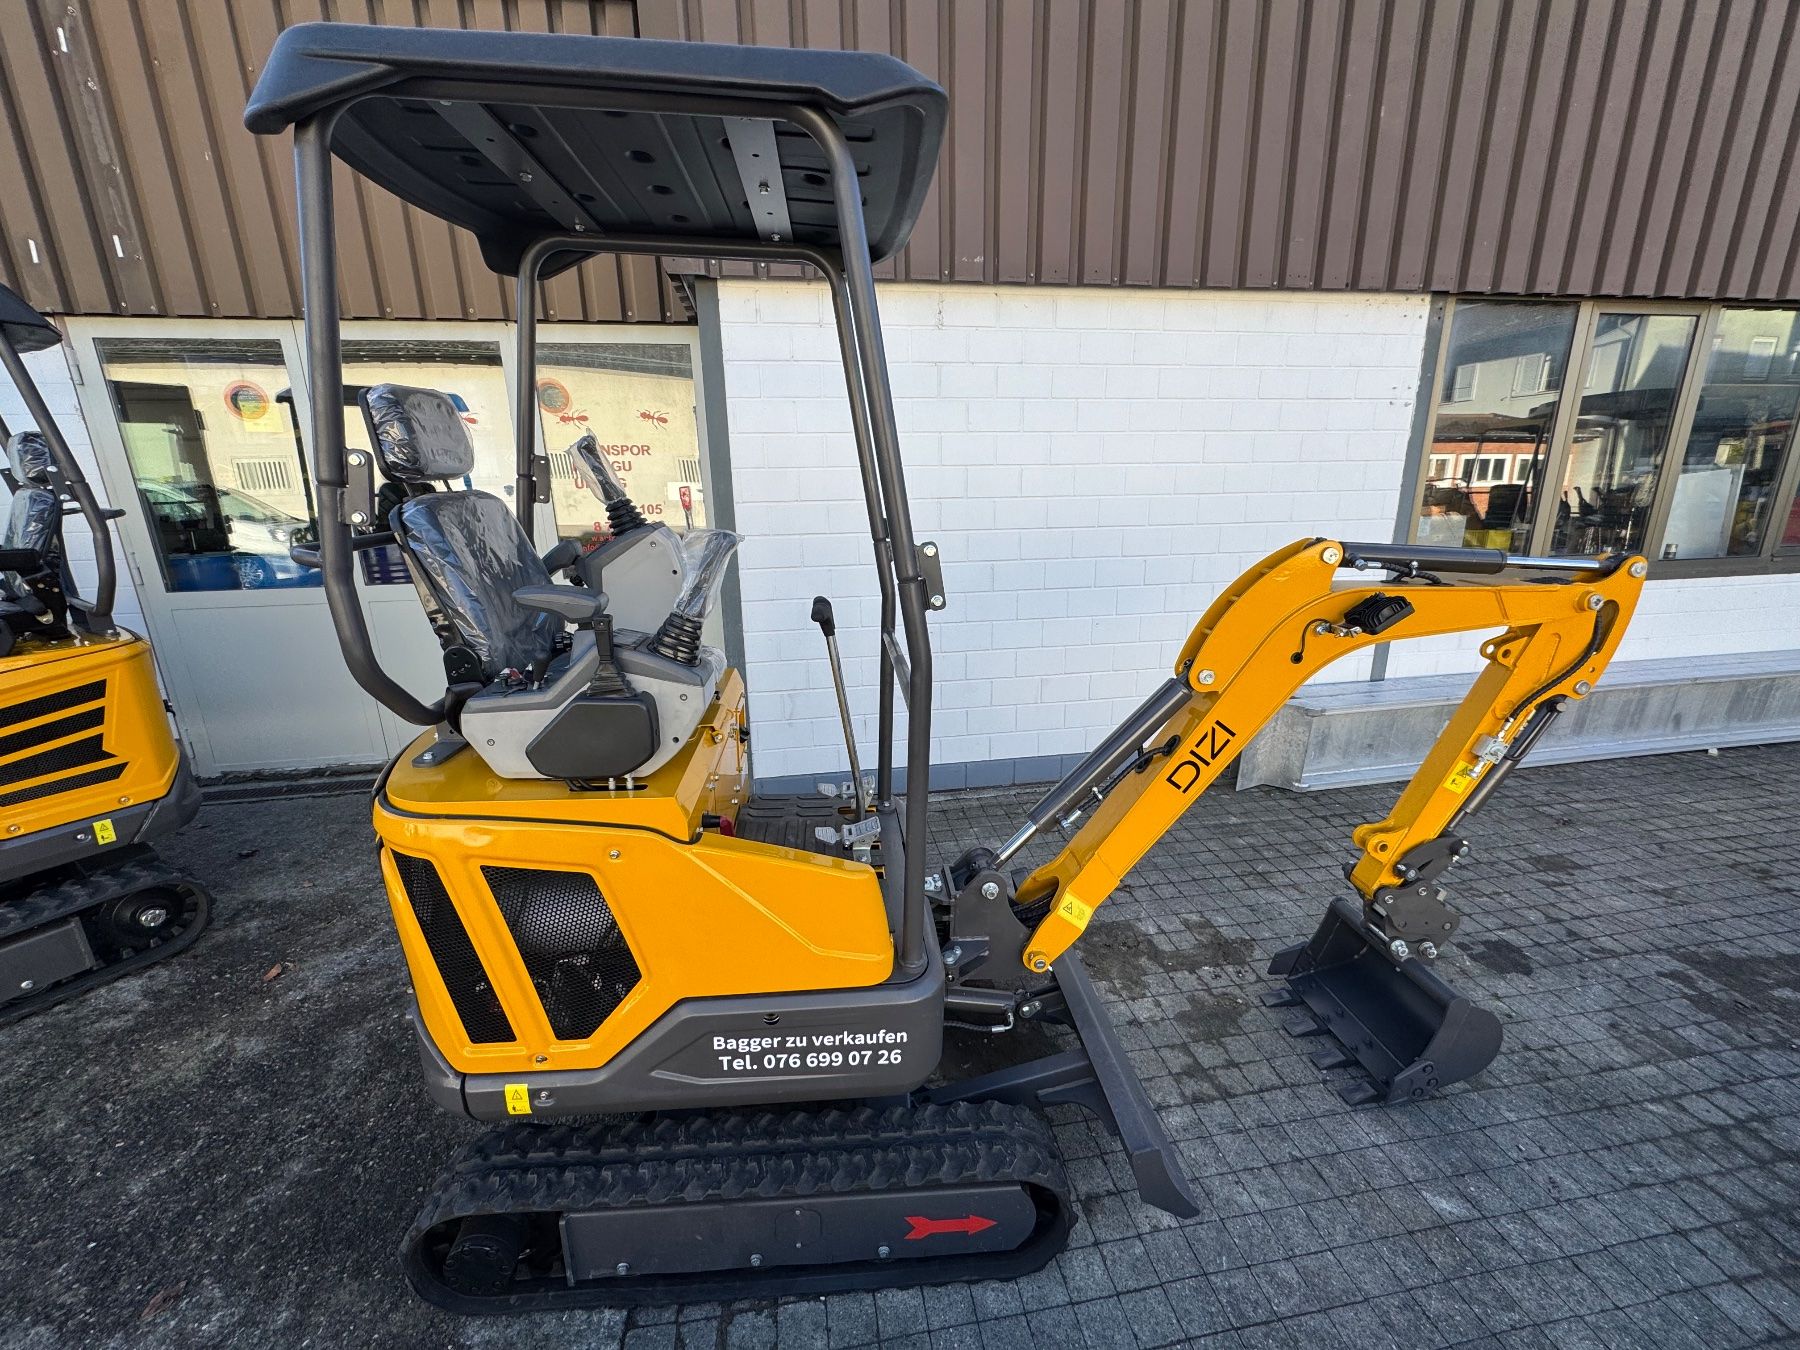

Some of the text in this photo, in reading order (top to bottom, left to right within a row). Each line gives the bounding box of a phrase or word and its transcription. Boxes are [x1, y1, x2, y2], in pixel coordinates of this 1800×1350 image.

[1166, 719, 1237, 794] DIZI
[713, 1029, 908, 1053] Bagger zu verkaufen
[718, 1049, 902, 1071] Tel. 076 699 07 26
